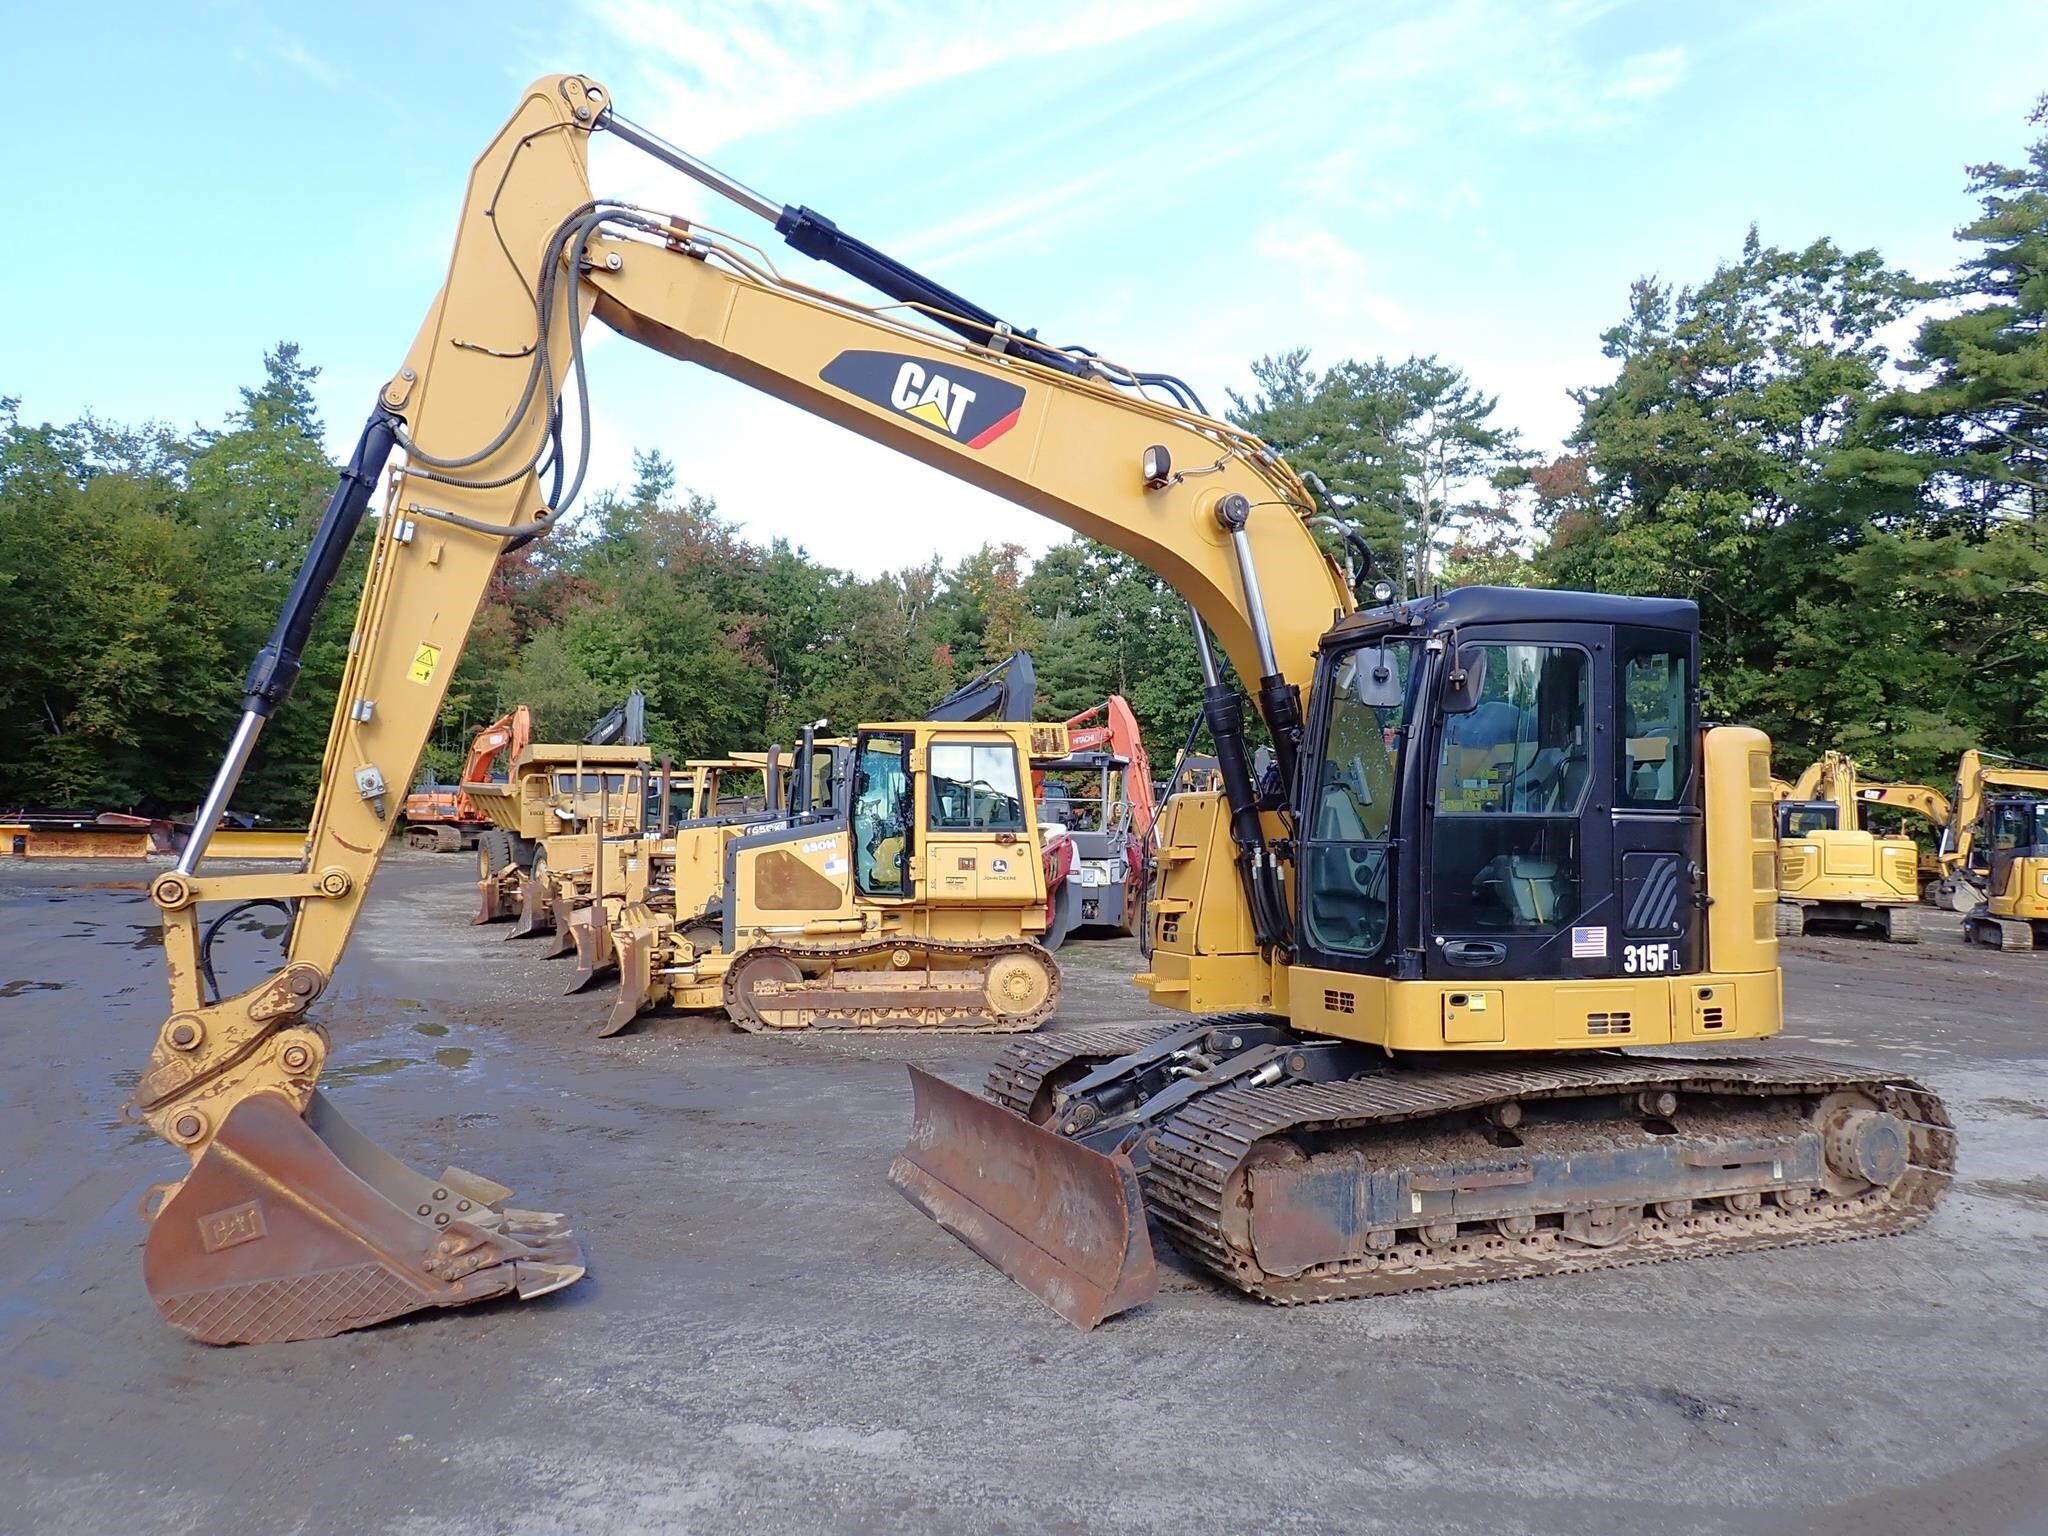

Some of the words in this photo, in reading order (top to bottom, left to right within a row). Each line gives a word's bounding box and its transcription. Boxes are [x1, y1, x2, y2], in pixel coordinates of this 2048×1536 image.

[891, 361, 976, 434] CAT
[1072, 734, 1095, 744] HITACHI
[1864, 789, 1880, 799] CAT
[643, 832, 661, 840] CAT
[802, 839, 837, 853] 650H
[1623, 944, 1669, 973] 315F
[1672, 949, 1681, 971] L
